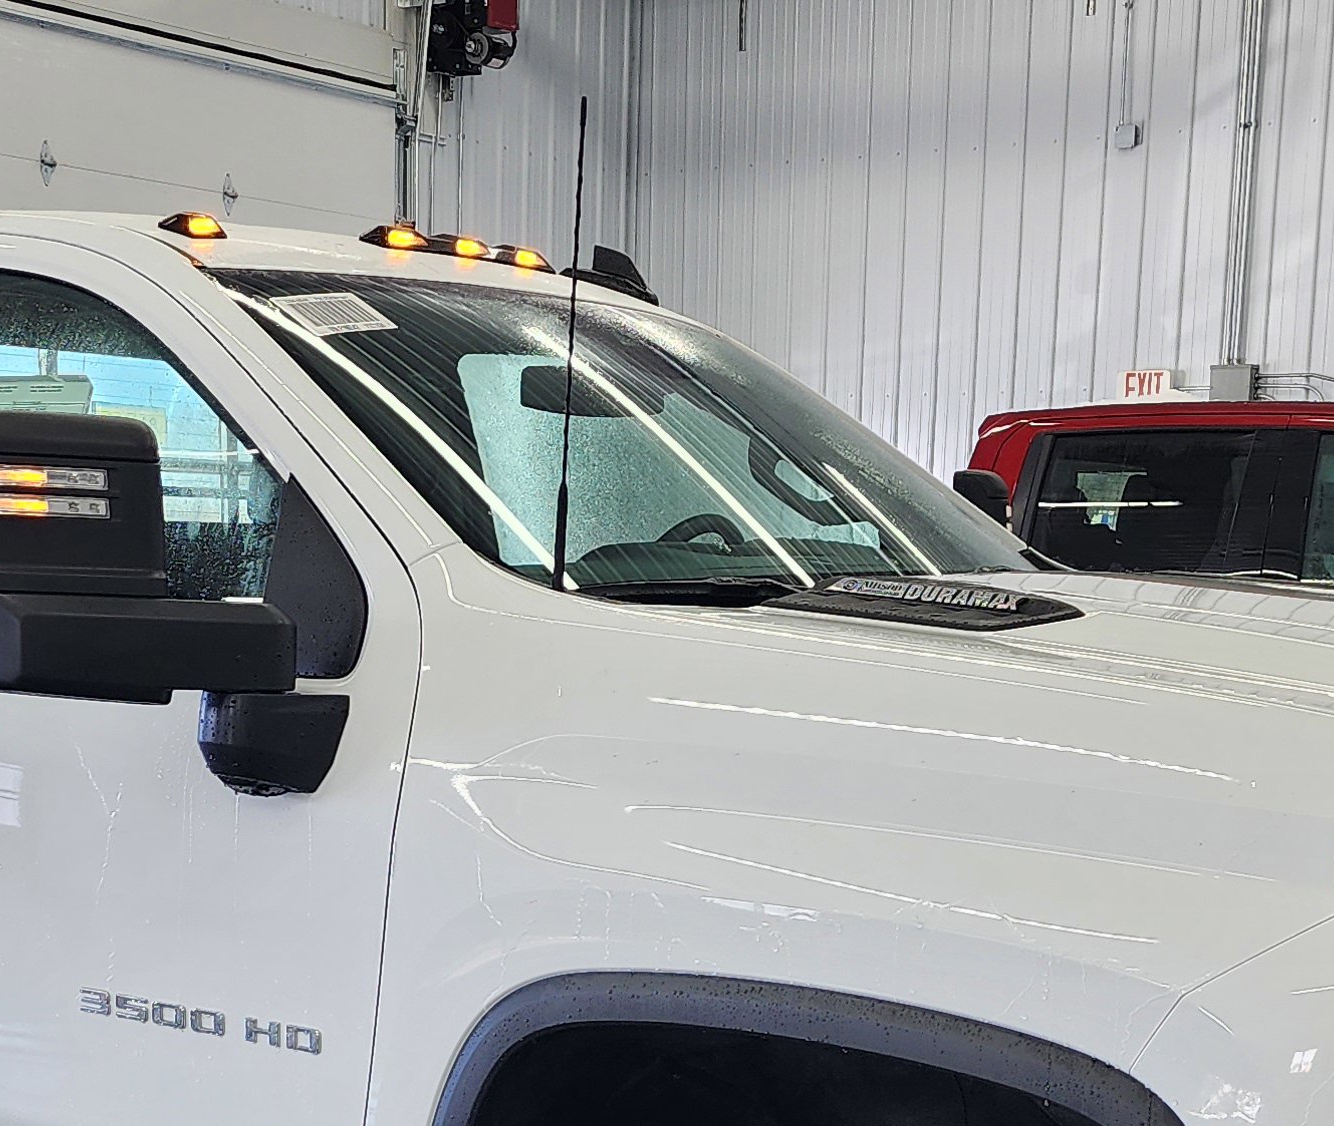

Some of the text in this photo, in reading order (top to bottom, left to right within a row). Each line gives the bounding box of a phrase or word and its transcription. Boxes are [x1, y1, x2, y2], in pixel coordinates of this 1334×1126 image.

[1125, 372, 1164, 397] EXIT
[906, 583, 1018, 611] DURAMAX
[78, 986, 323, 1055] 3500 HD
